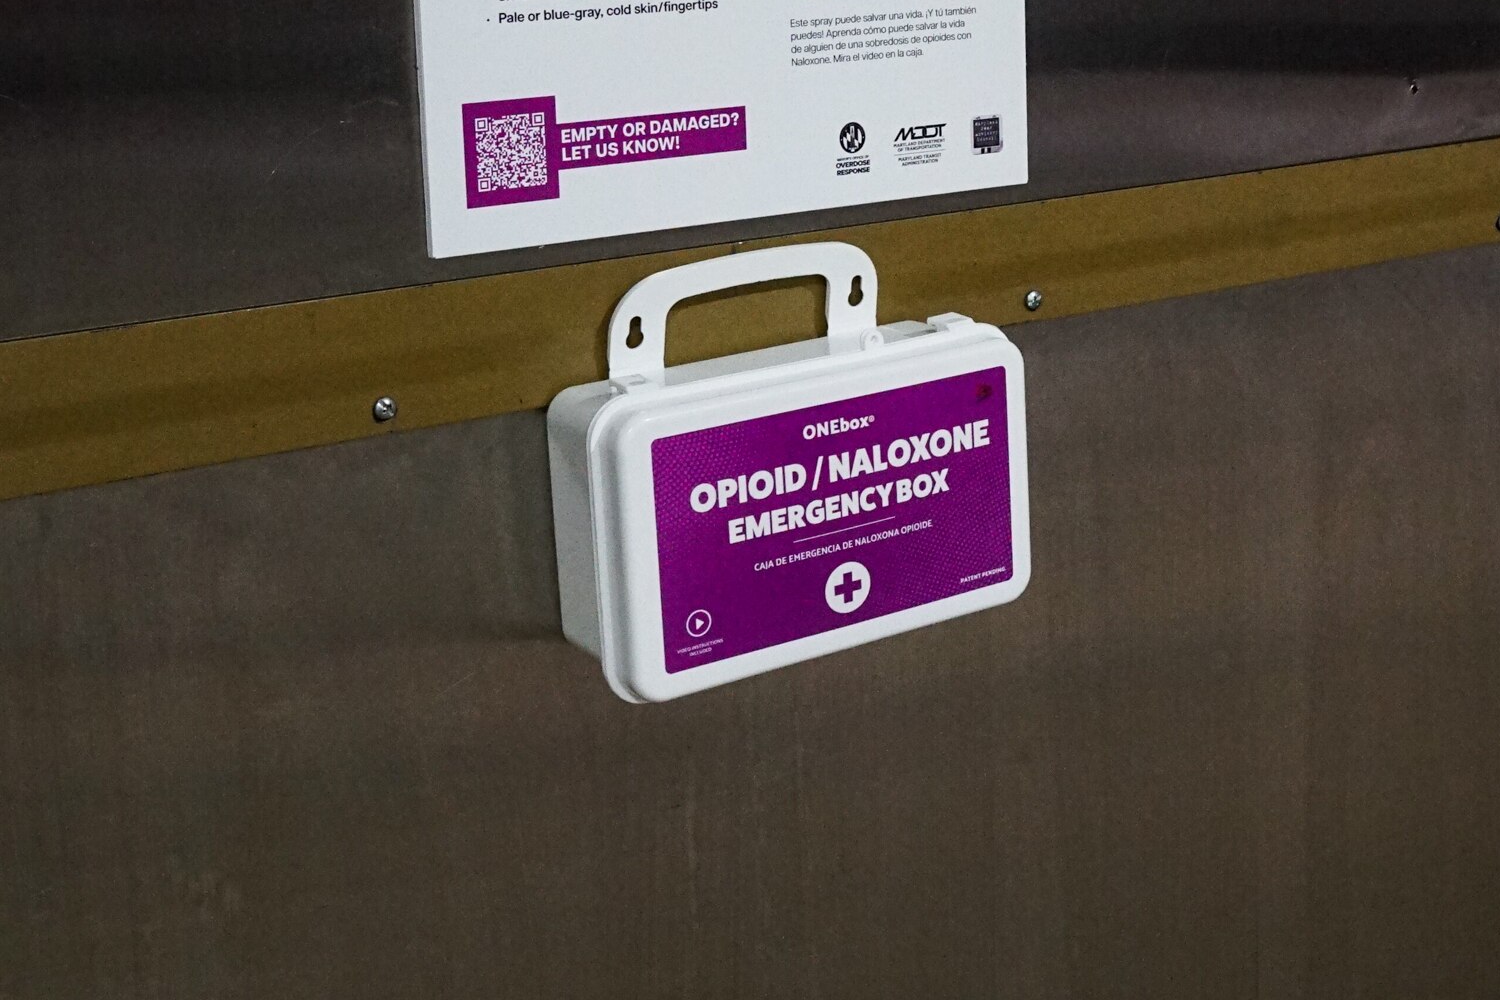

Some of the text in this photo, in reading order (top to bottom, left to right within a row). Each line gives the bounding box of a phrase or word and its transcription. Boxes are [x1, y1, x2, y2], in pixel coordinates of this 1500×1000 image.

[499, 0, 718, 23] Pale or blue-gray, cold skin/fingertips
[790, 18, 808, 28] Este
[810, 17, 833, 28] spray
[835, 15, 861, 26] puede
[863, 13, 886, 23] salvar
[889, 12, 903, 21] una
[906, 11, 923, 19] vida.
[945, 7, 976, 16] también
[791, 31, 824, 42] puedes!
[826, 28, 862, 38] Aprenda
[863, 26, 887, 35] cómo
[888, 24, 914, 33] puede
[915, 22, 938, 31] salvar
[949, 20, 965, 28] vida
[561, 112, 739, 144] EMPTY OR DAMAGED?
[562, 136, 680, 161] LET US KNOW!
[836, 160, 870, 168] OVERDOSE
[837, 167, 870, 176] RESPONSE
[690, 419, 990, 513] OPIOID NALOXONE
[728, 468, 950, 544] EMERGENCY BOX
[754, 519, 932, 571] CAJA DE EMERGENCIA DE NALOXONA OPIOIDE
